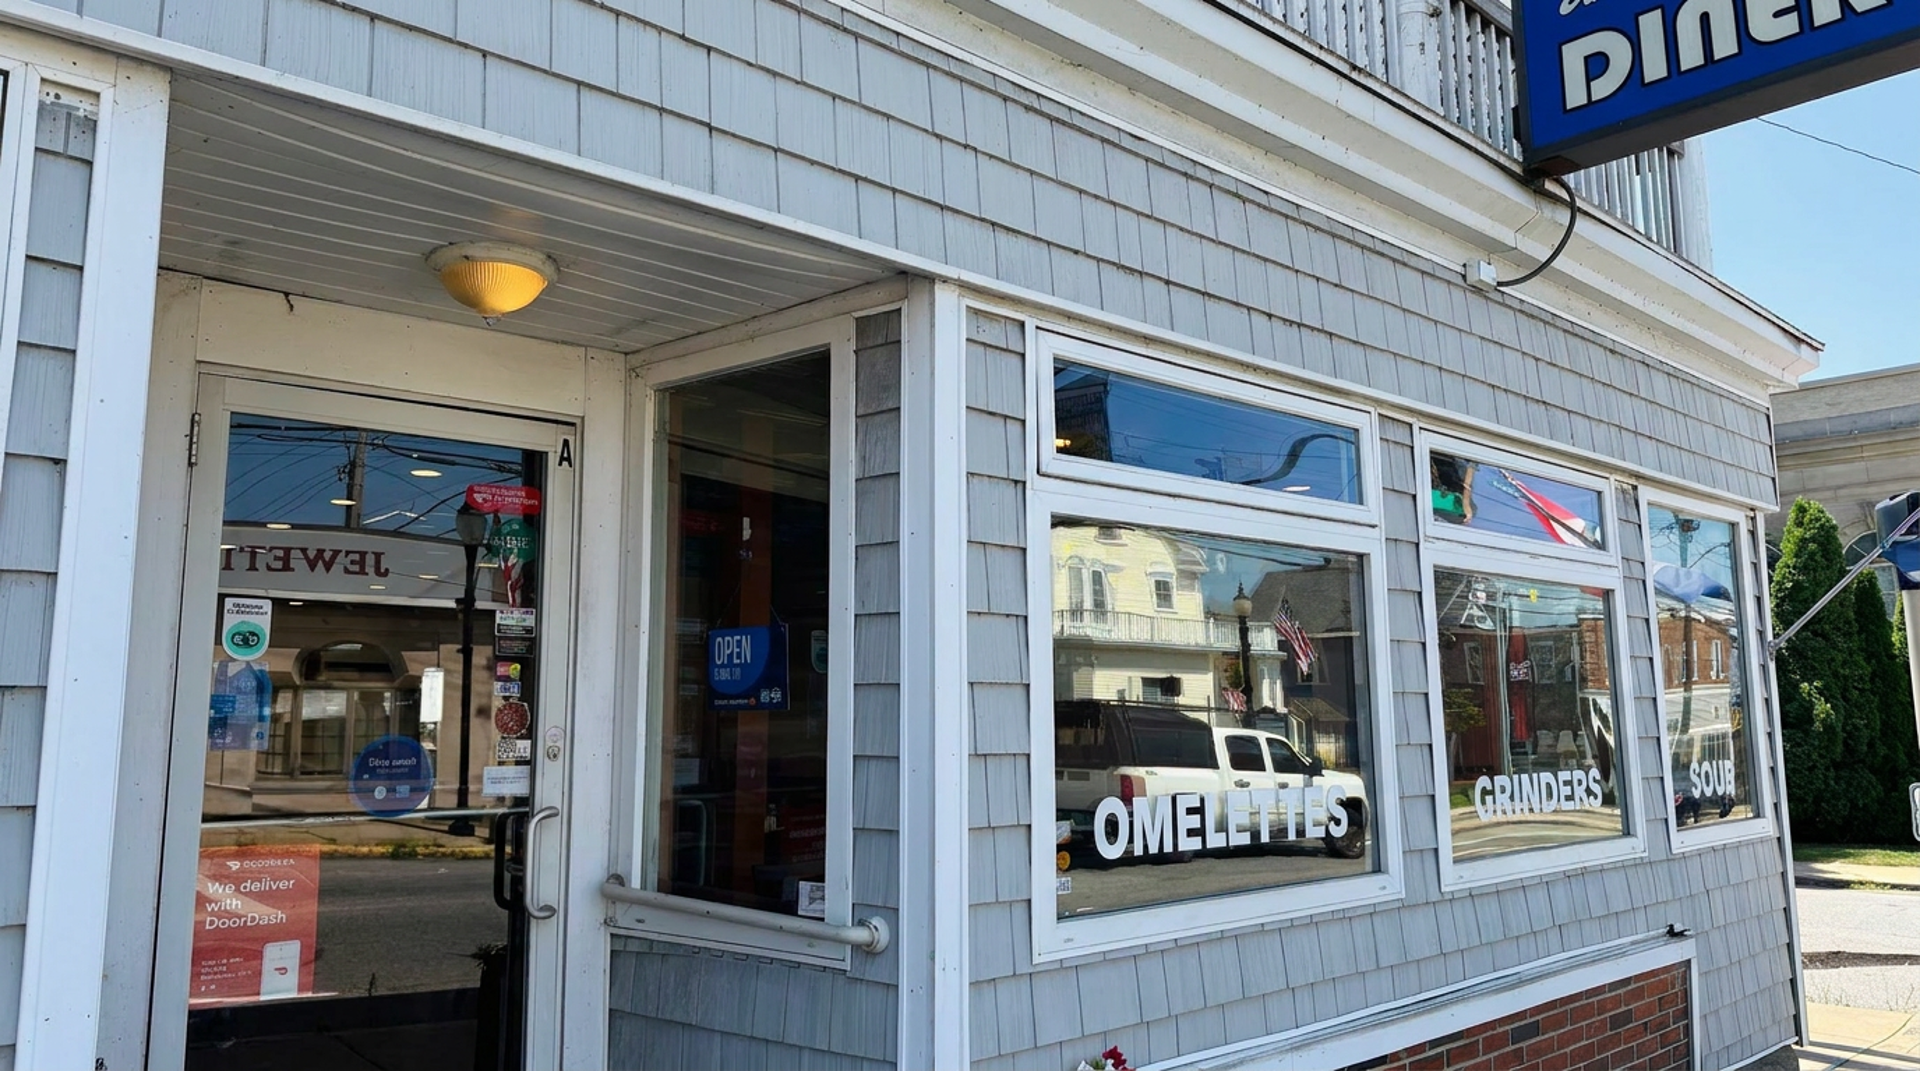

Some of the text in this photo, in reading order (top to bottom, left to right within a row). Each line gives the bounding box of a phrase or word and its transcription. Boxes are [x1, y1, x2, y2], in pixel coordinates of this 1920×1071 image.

[558, 438, 573, 468] A
[715, 635, 752, 665] OPEN
[1475, 768, 1602, 821] GRINDERS
[1094, 785, 1349, 860] OMELETTES
[207, 877, 295, 894] We deliver
[206, 898, 241, 912] with
[205, 911, 286, 930] DoorDash
